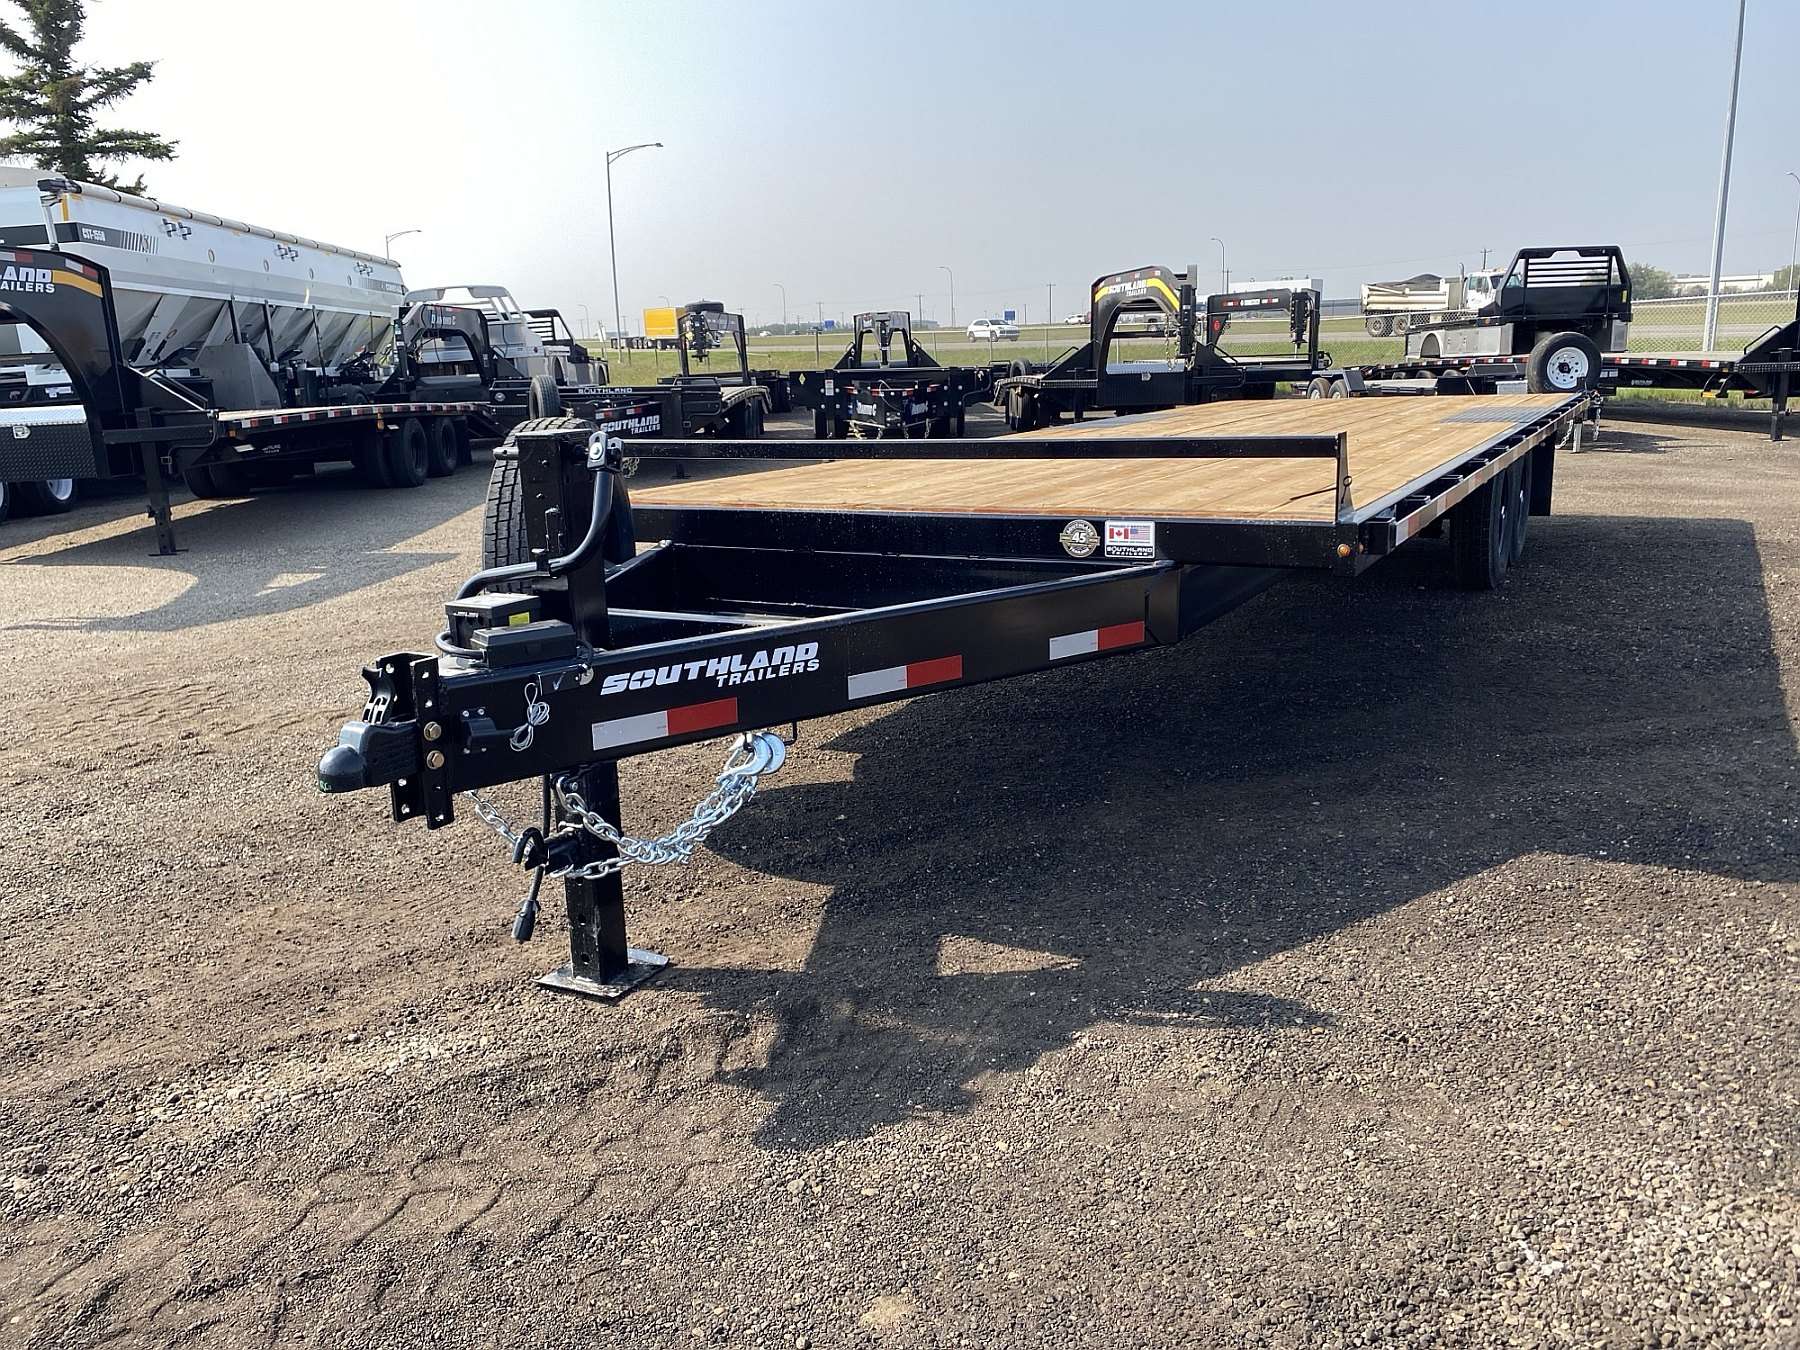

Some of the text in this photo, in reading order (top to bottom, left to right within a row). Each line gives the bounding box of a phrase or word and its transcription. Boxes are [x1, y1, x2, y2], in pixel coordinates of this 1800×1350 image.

[0, 265, 52, 283] AND
[1108, 279, 1147, 294] SOUTHLAND
[578, 387, 632, 395] SOUTHLAND
[600, 415, 660, 433] SOUTHLAND
[631, 423, 660, 435] TRAILERS
[1072, 532, 1087, 543] 45
[1106, 545, 1153, 553] SOUTHLAND
[599, 641, 819, 696] SOUTHLAND
[716, 658, 820, 688] TRAILERS
